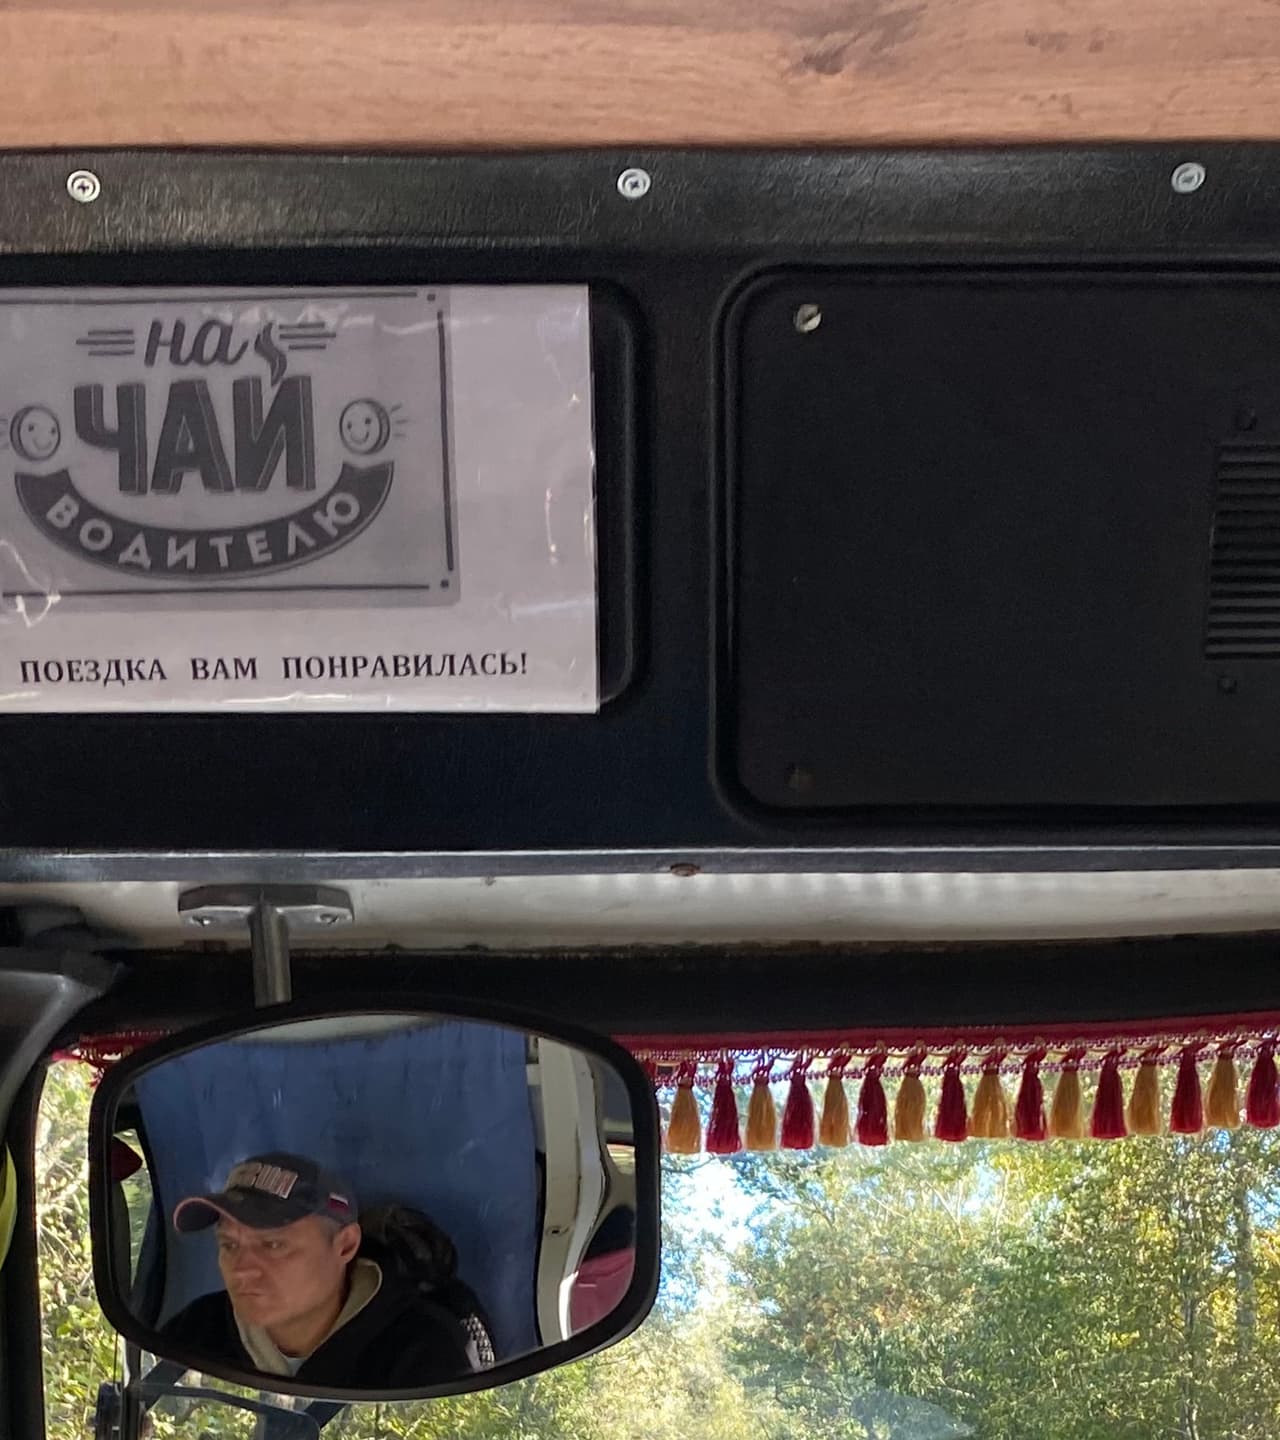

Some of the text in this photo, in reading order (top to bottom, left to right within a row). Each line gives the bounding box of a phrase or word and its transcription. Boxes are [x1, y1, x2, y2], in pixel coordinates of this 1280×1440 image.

[45, 492, 361, 571] ВОДИТЕЛЮ
[19, 658, 168, 687] ПОЕЗДКА
[190, 657, 258, 681] ВАМ
[281, 651, 528, 681] ПОНРАВИЛАСЬ!
